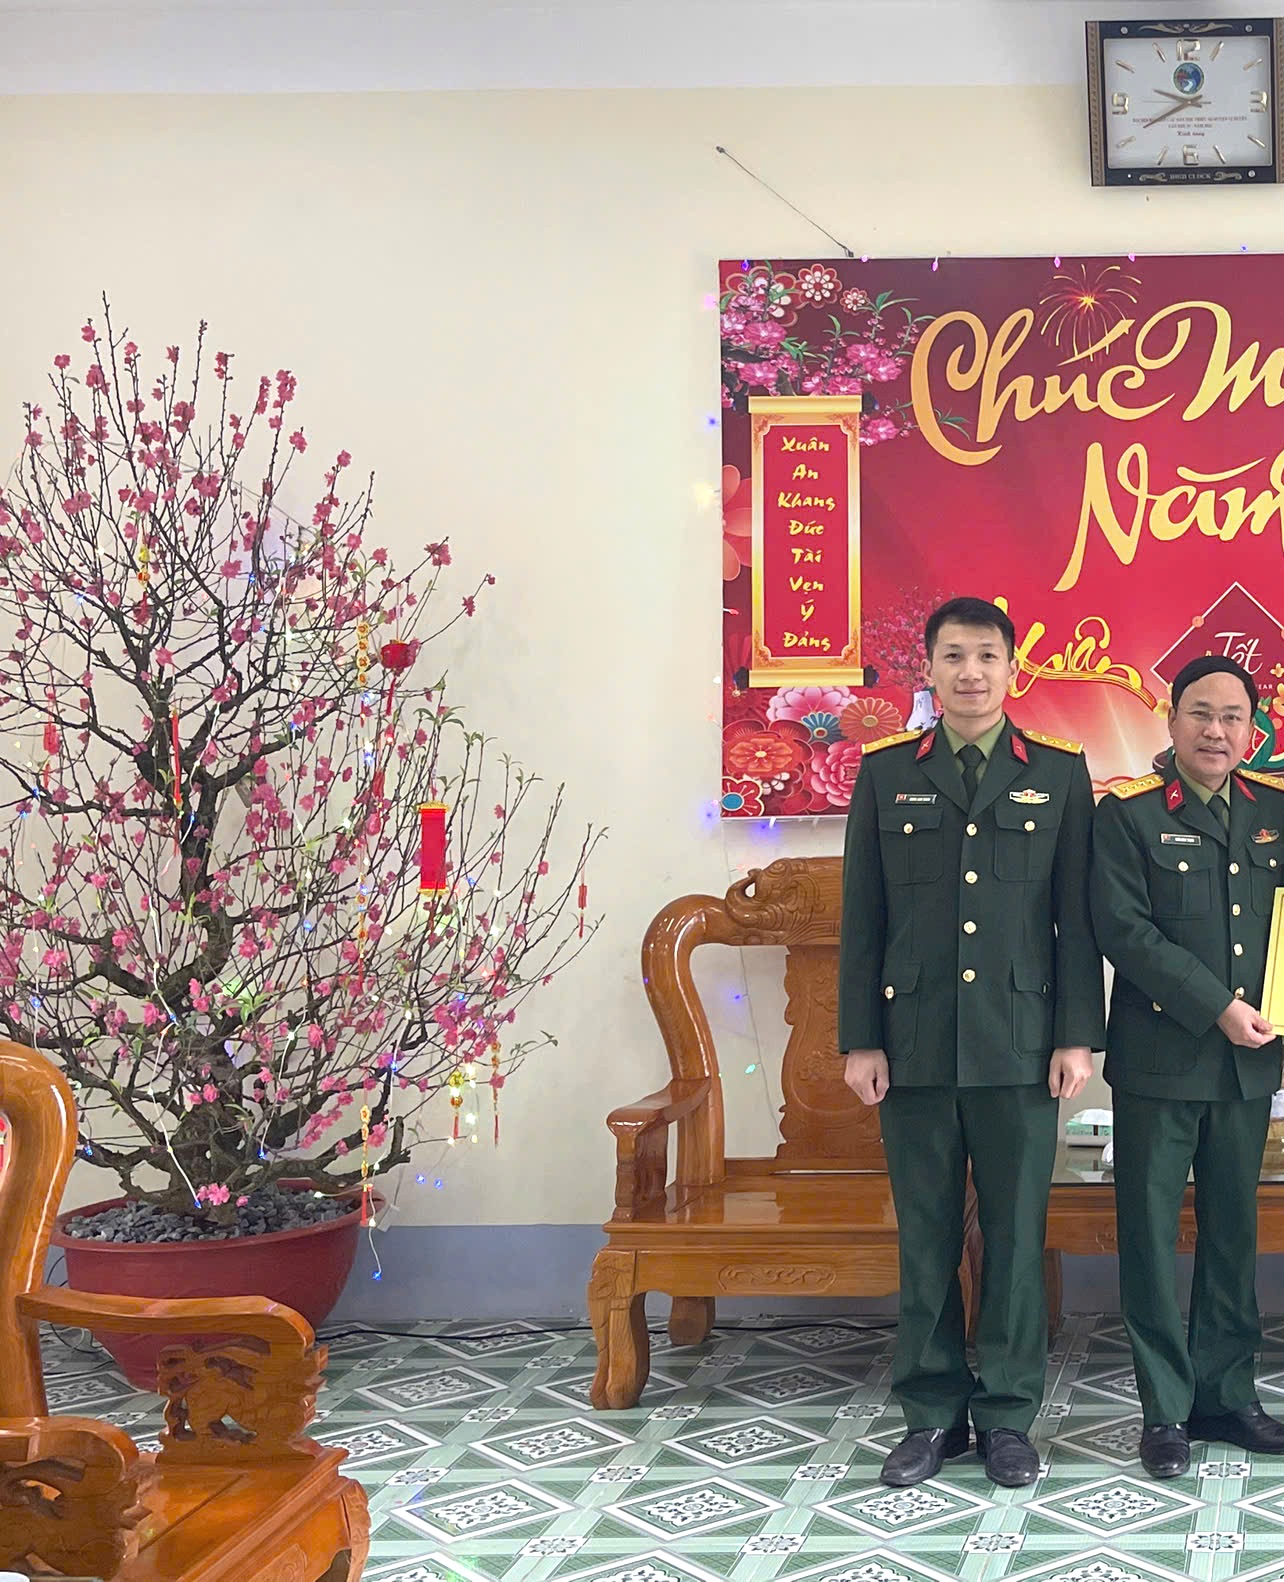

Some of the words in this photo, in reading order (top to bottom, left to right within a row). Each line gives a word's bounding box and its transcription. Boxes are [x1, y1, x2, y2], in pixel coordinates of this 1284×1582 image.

[911, 308, 1175, 466] Chúc
[781, 436, 831, 452] Xuân
[791, 463, 819, 481] An
[777, 491, 836, 512] Khang
[788, 519, 824, 536] Đức
[791, 548, 822, 564] Tài
[789, 575, 824, 595] Vẹn
[800, 599, 815, 622] Ý
[783, 631, 831, 652] Đảng
